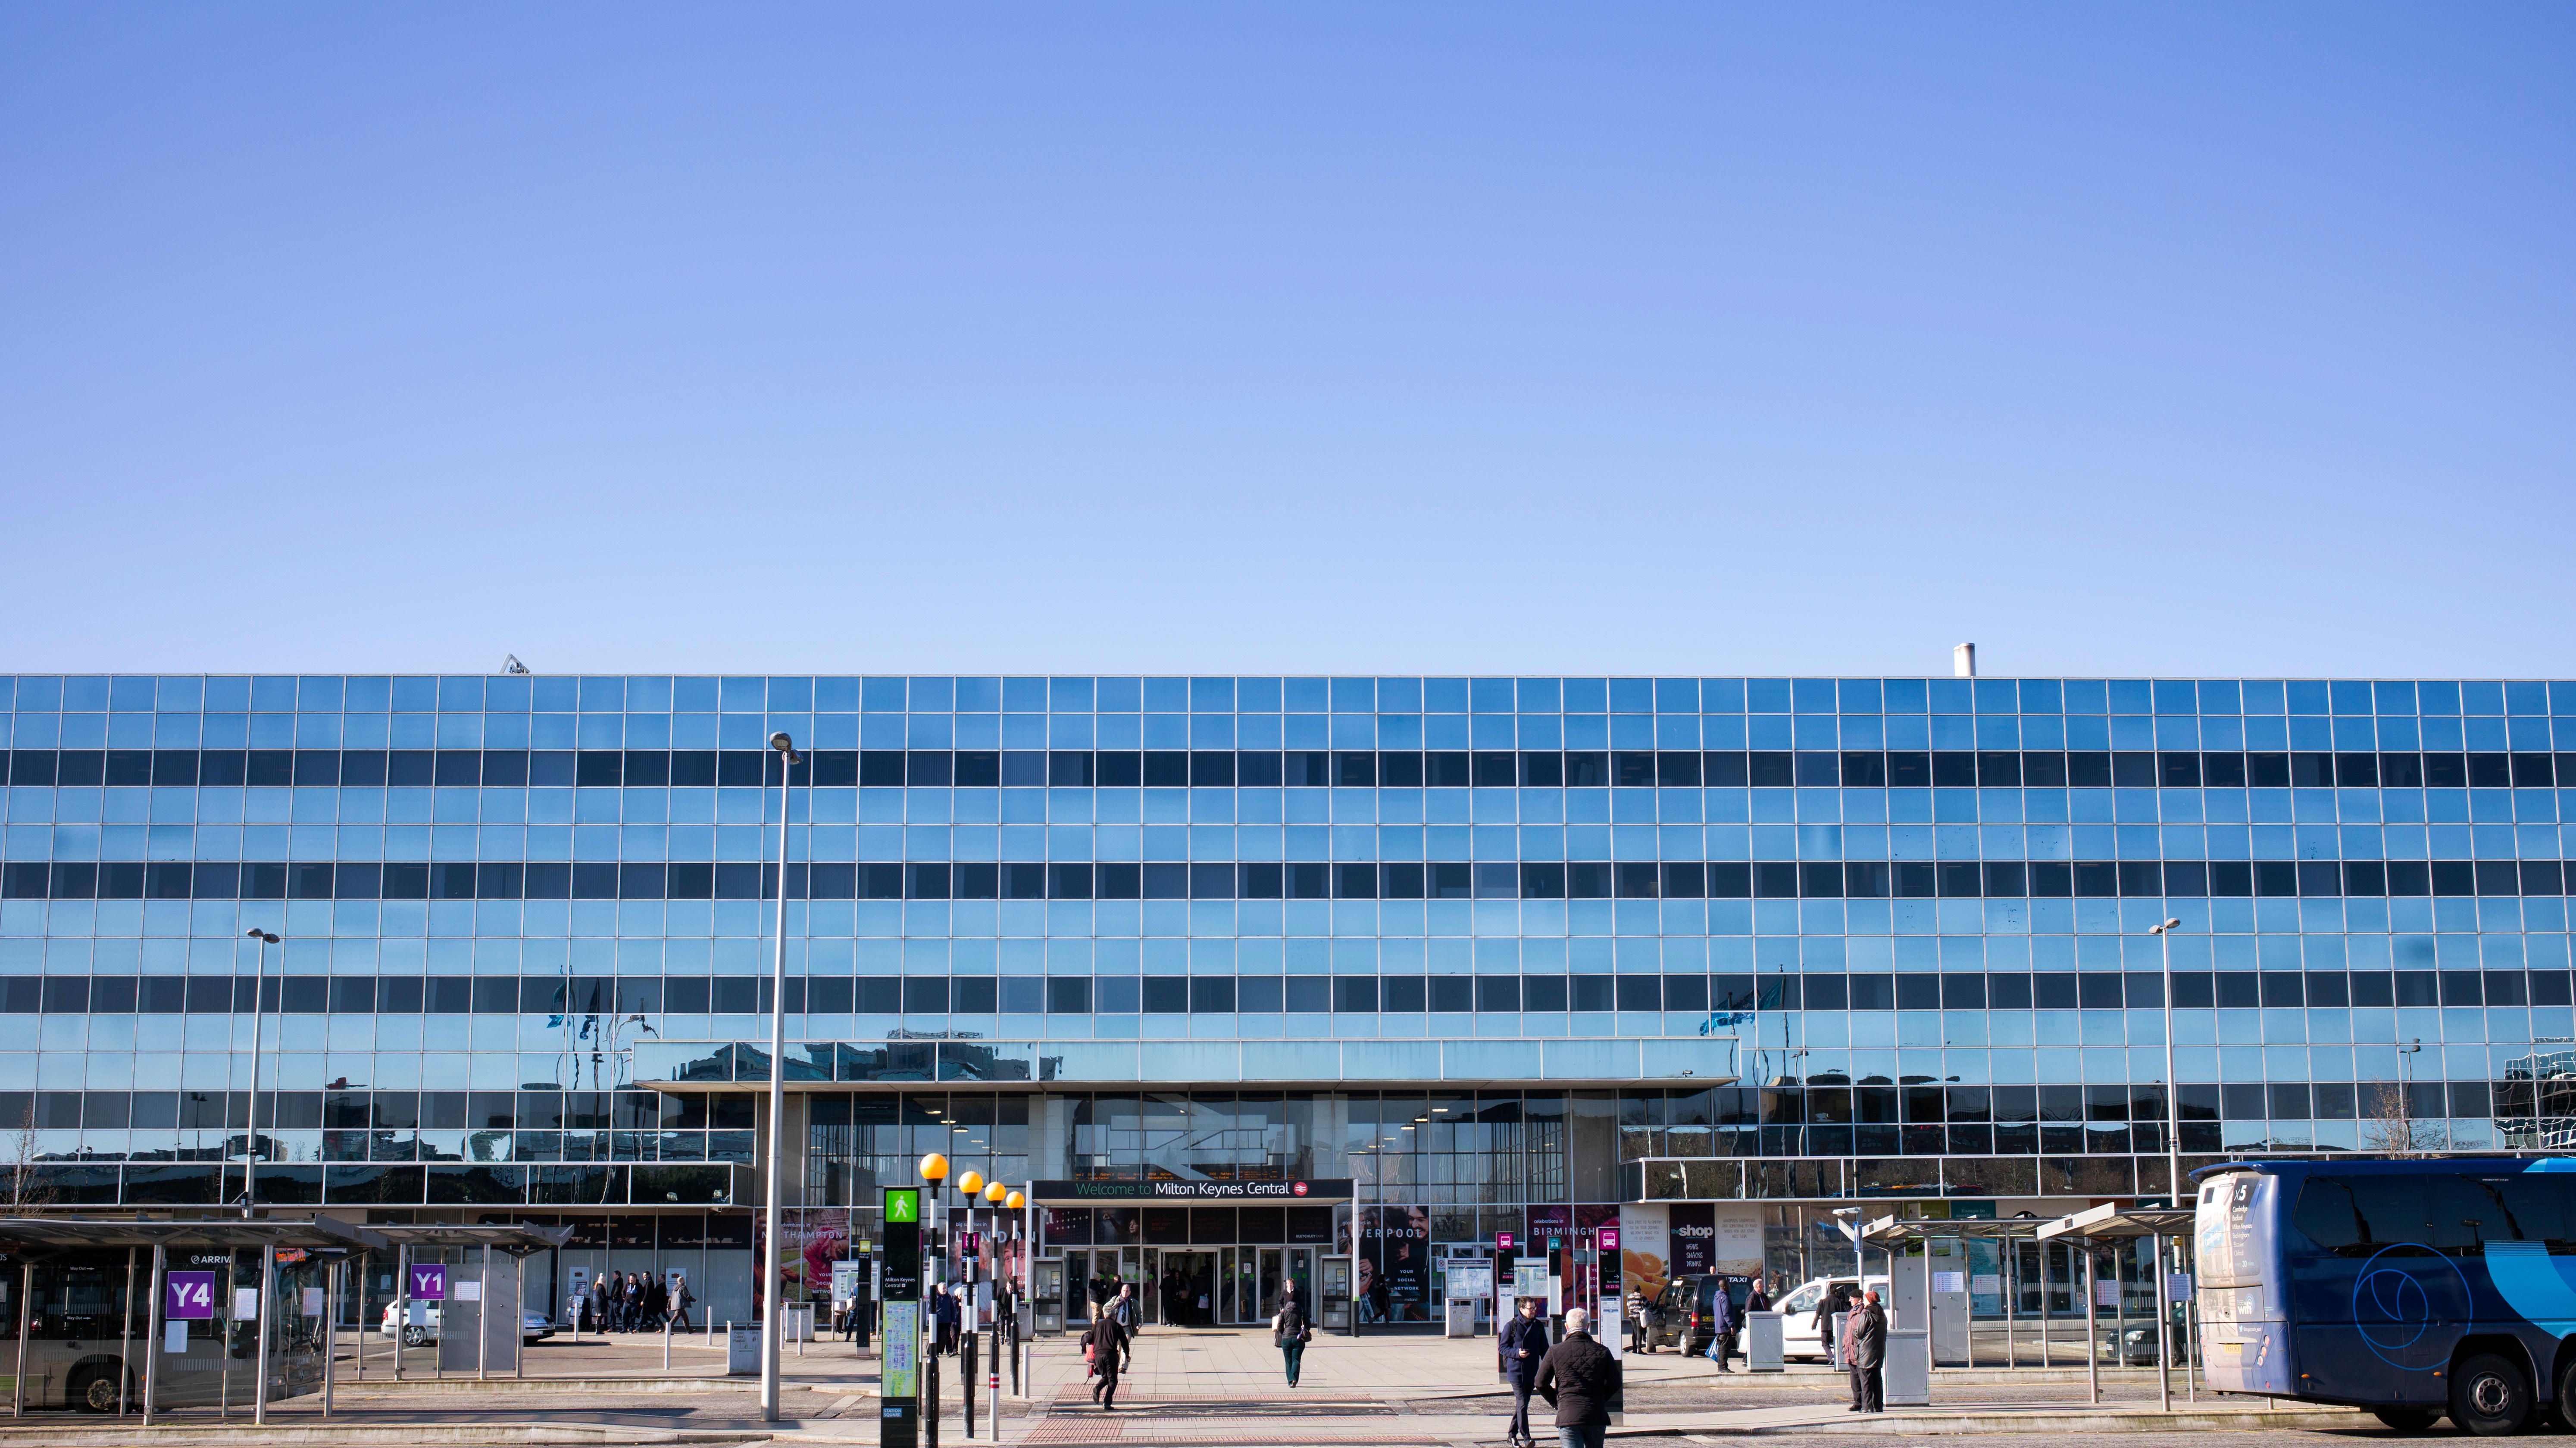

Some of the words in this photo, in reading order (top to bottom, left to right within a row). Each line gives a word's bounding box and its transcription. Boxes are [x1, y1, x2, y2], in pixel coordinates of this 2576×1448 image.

[1076, 1183, 1135, 1195] Welcome
[1139, 1184, 1151, 1195] to
[1156, 1183, 1194, 1195] Milton
[1199, 1182, 1243, 1198] Keynes
[1247, 1182, 1289, 1194] Central
[1533, 1227, 1595, 1236] BIRMINGH
[1679, 1224, 1713, 1238] shop
[415, 1273, 442, 1291] Y1
[171, 1283, 210, 1307] Y4
[2237, 1301, 2252, 1315] wifi
